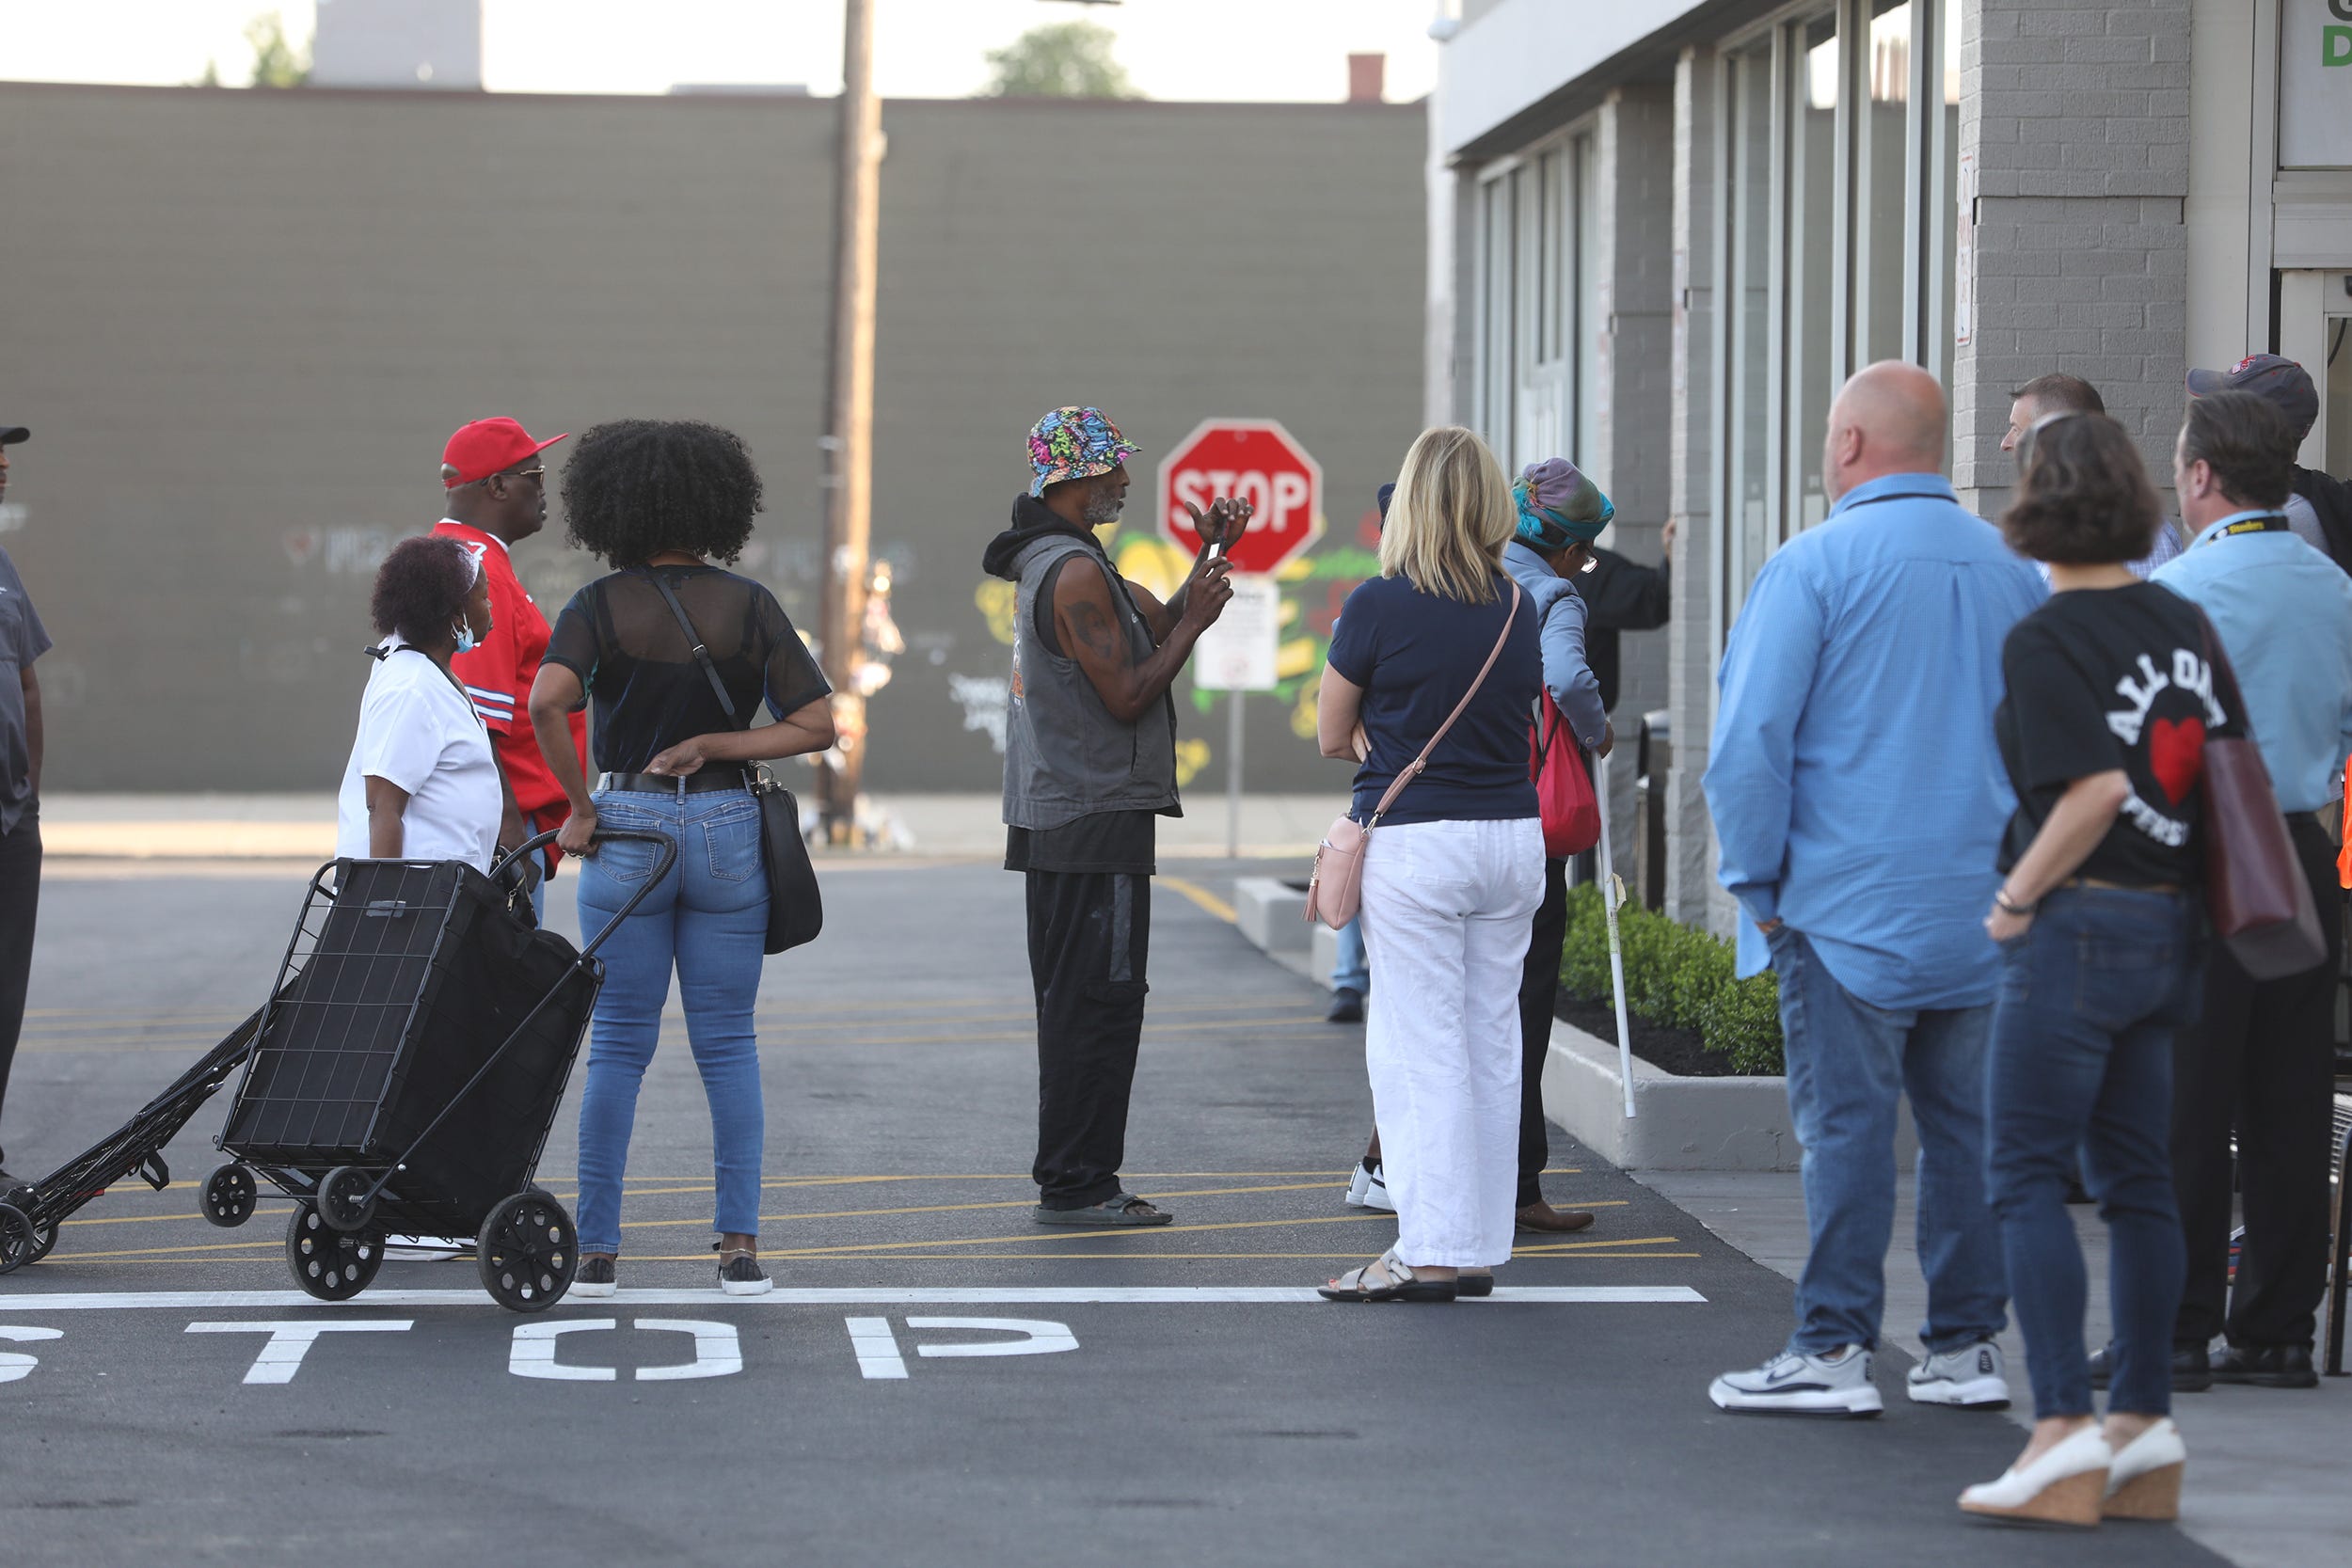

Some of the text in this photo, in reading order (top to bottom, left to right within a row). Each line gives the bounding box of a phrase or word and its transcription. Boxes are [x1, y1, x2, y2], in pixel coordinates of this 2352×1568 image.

[1172, 468, 1308, 533] STOP
[2106, 653, 2169, 746] ALL
[0, 1317, 1079, 1385] TOP
